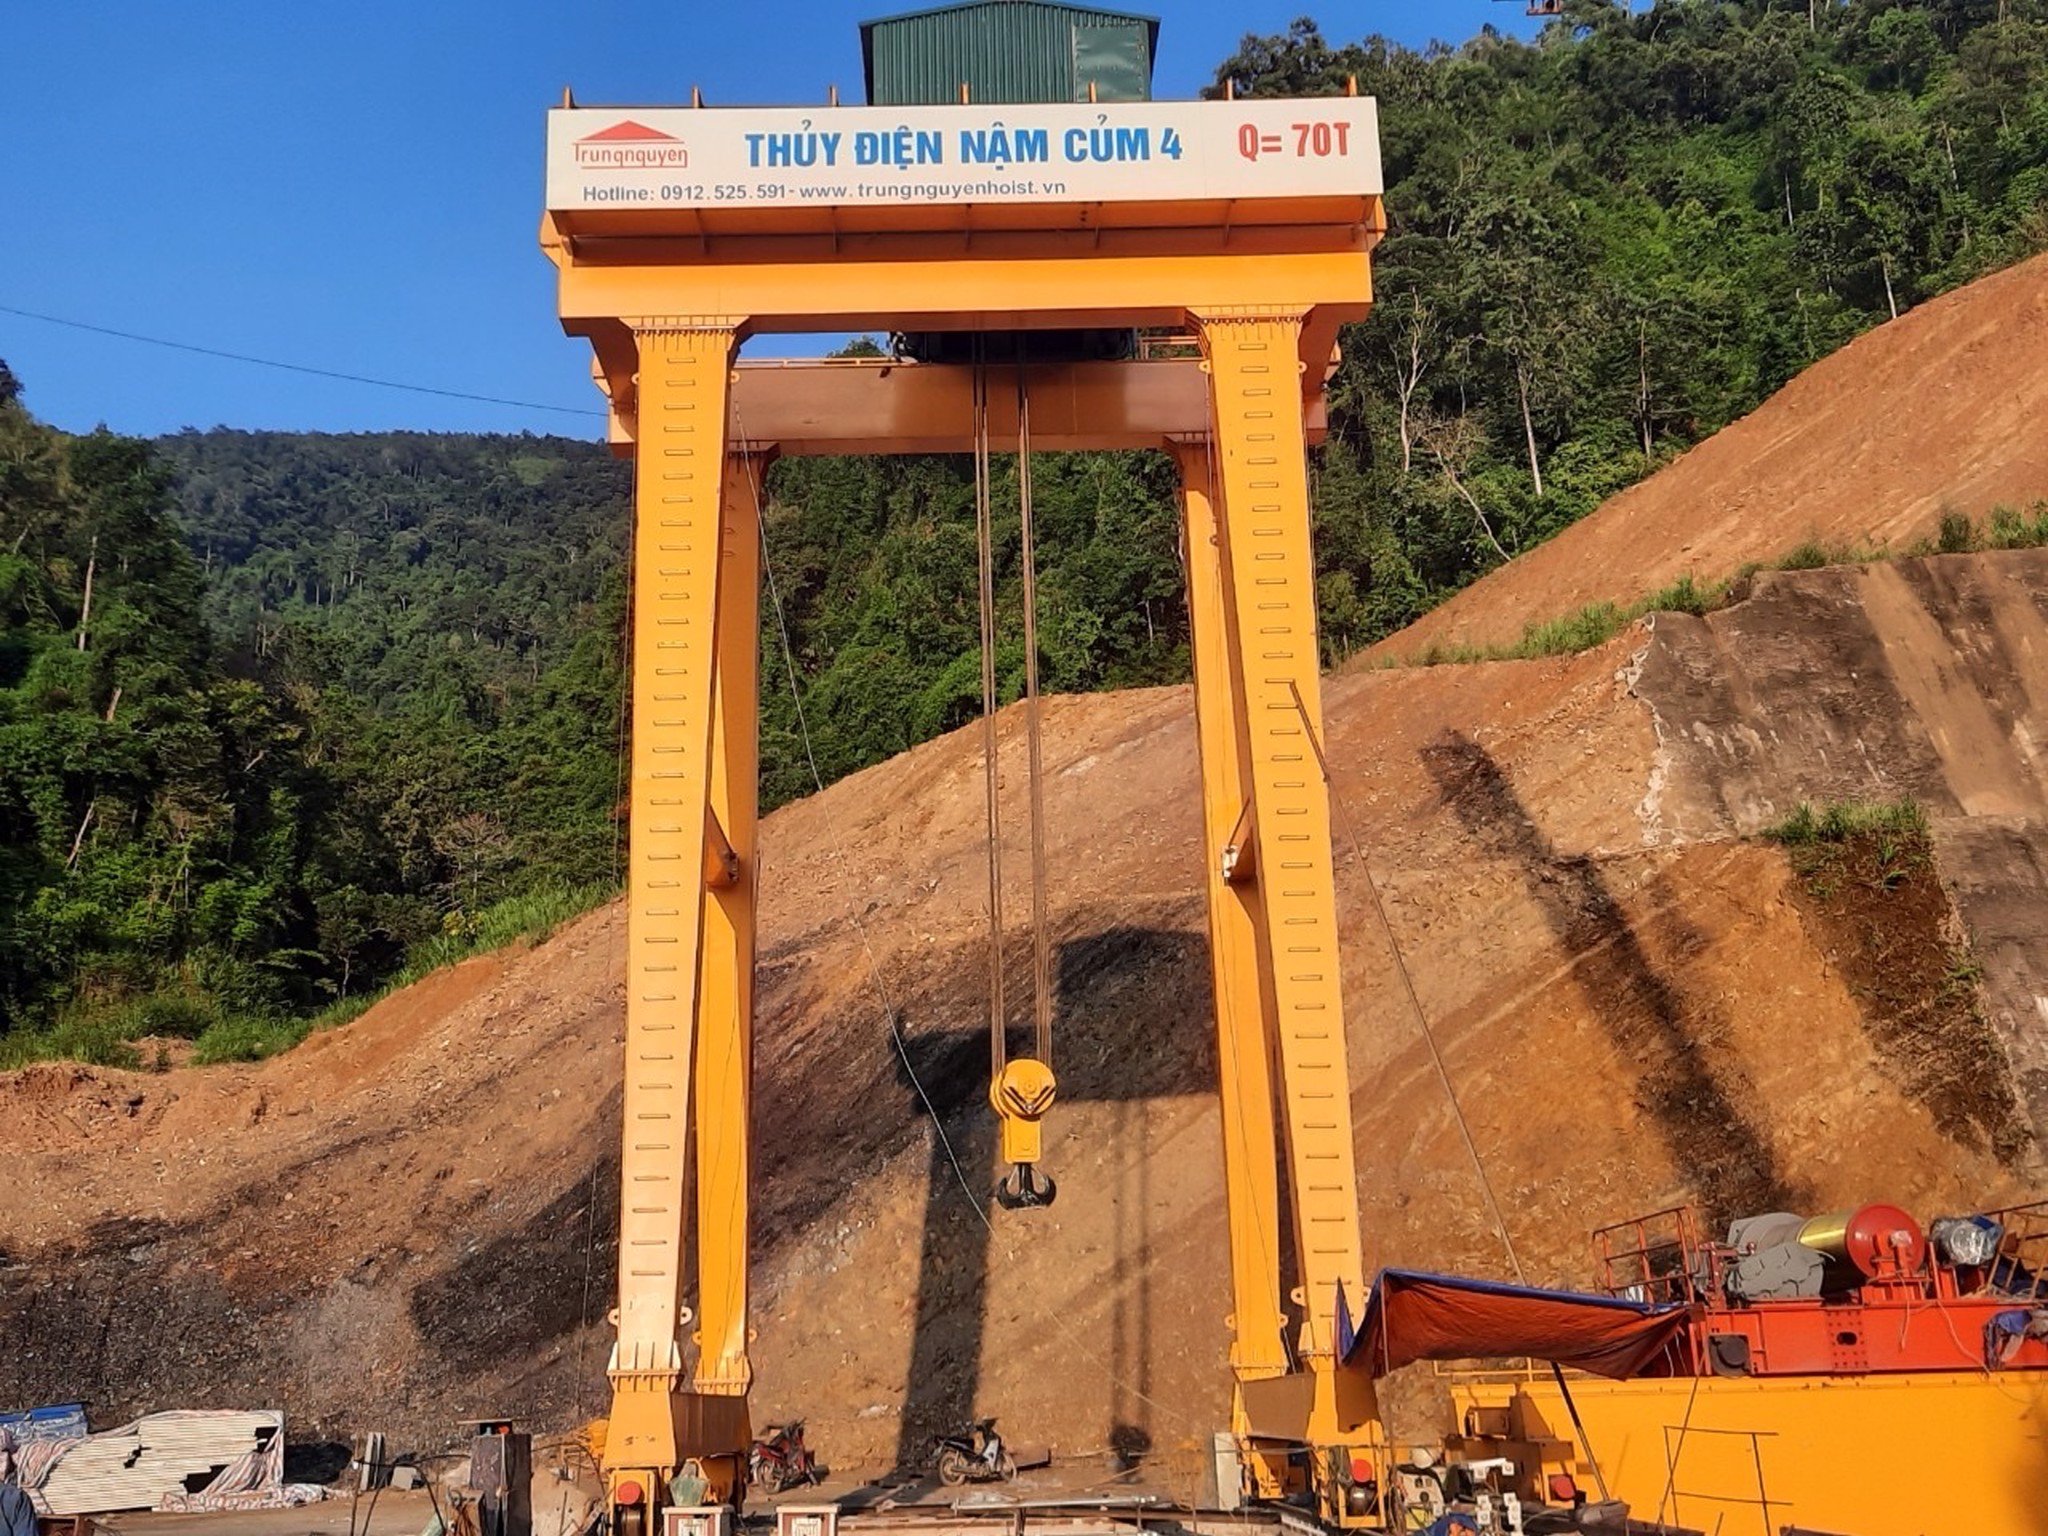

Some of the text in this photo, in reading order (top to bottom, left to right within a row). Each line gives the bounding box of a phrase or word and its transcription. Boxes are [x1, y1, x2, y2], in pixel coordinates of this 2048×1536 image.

[745, 114, 1183, 170] THỦY ĐIỆN NẬM CỦM 4
[1238, 122, 1351, 162] Q= 70T
[583, 186, 655, 201] Hotline:
